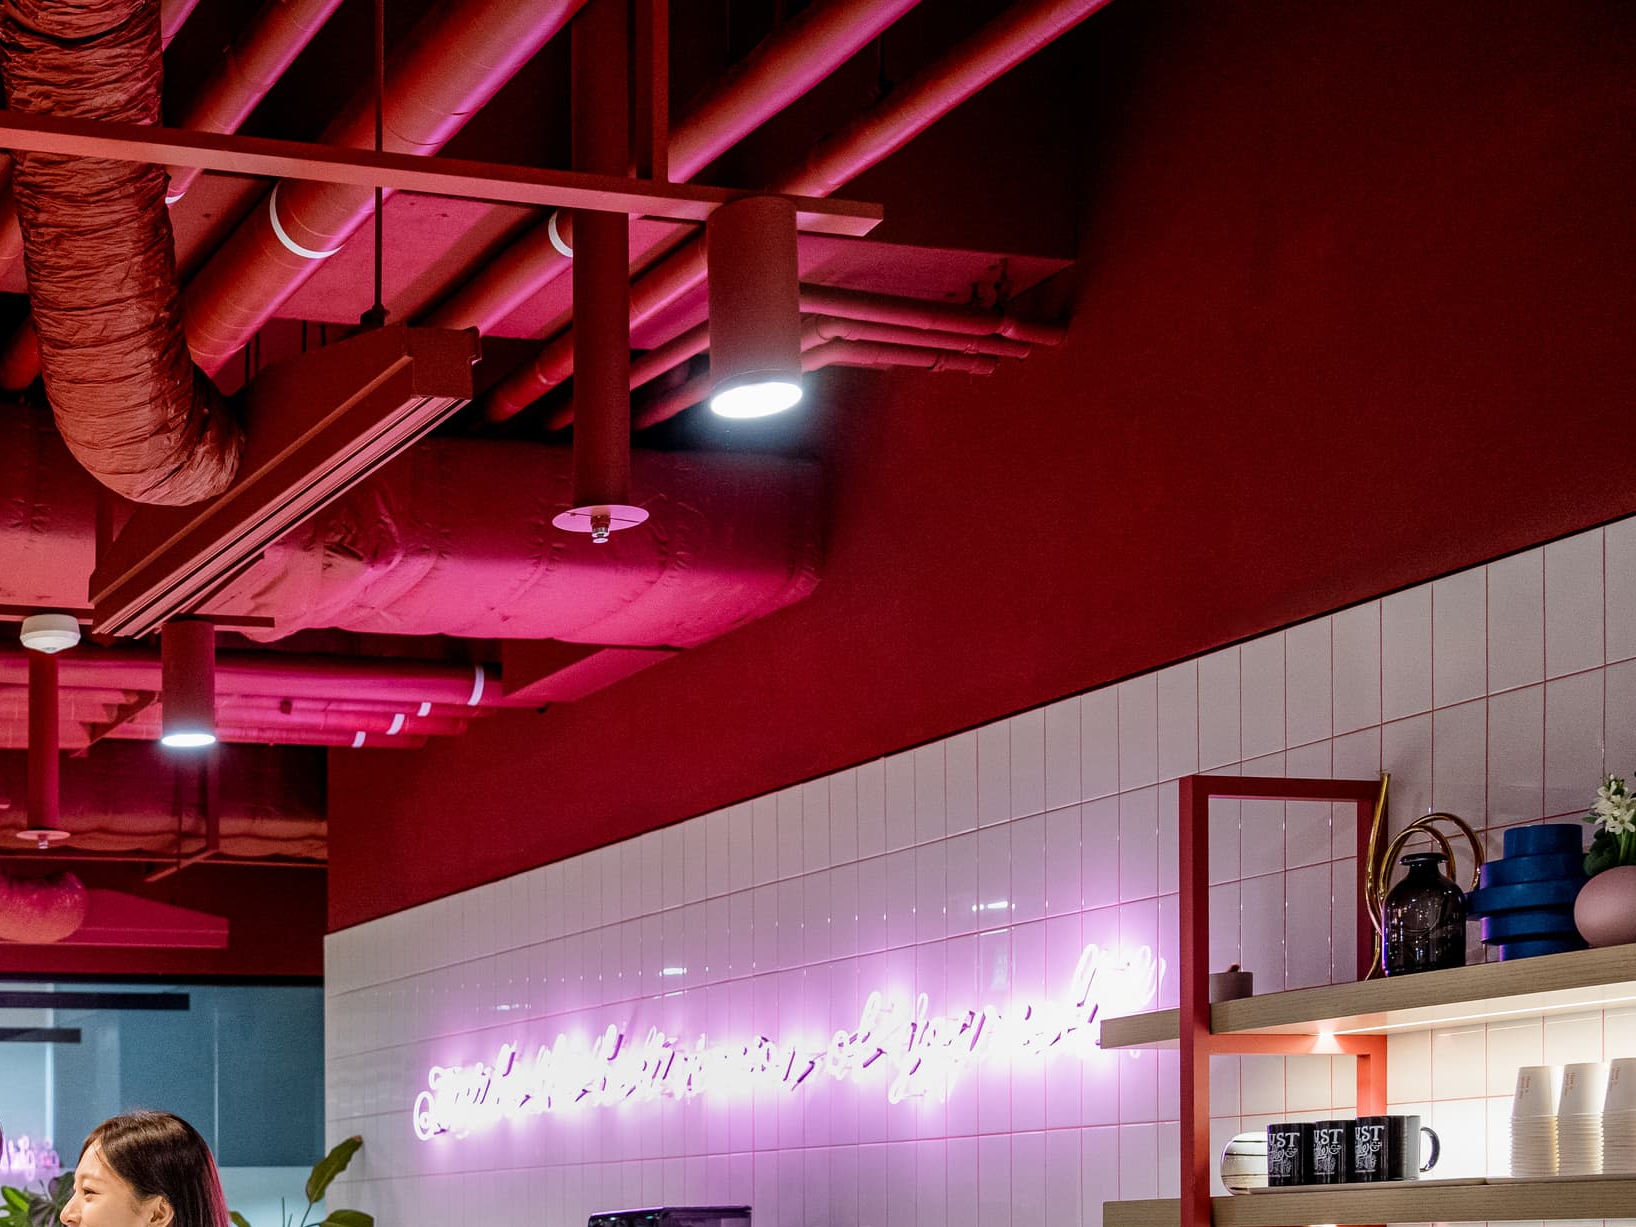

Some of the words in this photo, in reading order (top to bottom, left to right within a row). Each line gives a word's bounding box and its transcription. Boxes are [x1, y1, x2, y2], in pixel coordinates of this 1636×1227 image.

[1268, 1132, 1300, 1148] UST
[1313, 1128, 1343, 1144] UST
[1355, 1125, 1384, 1141] UST
